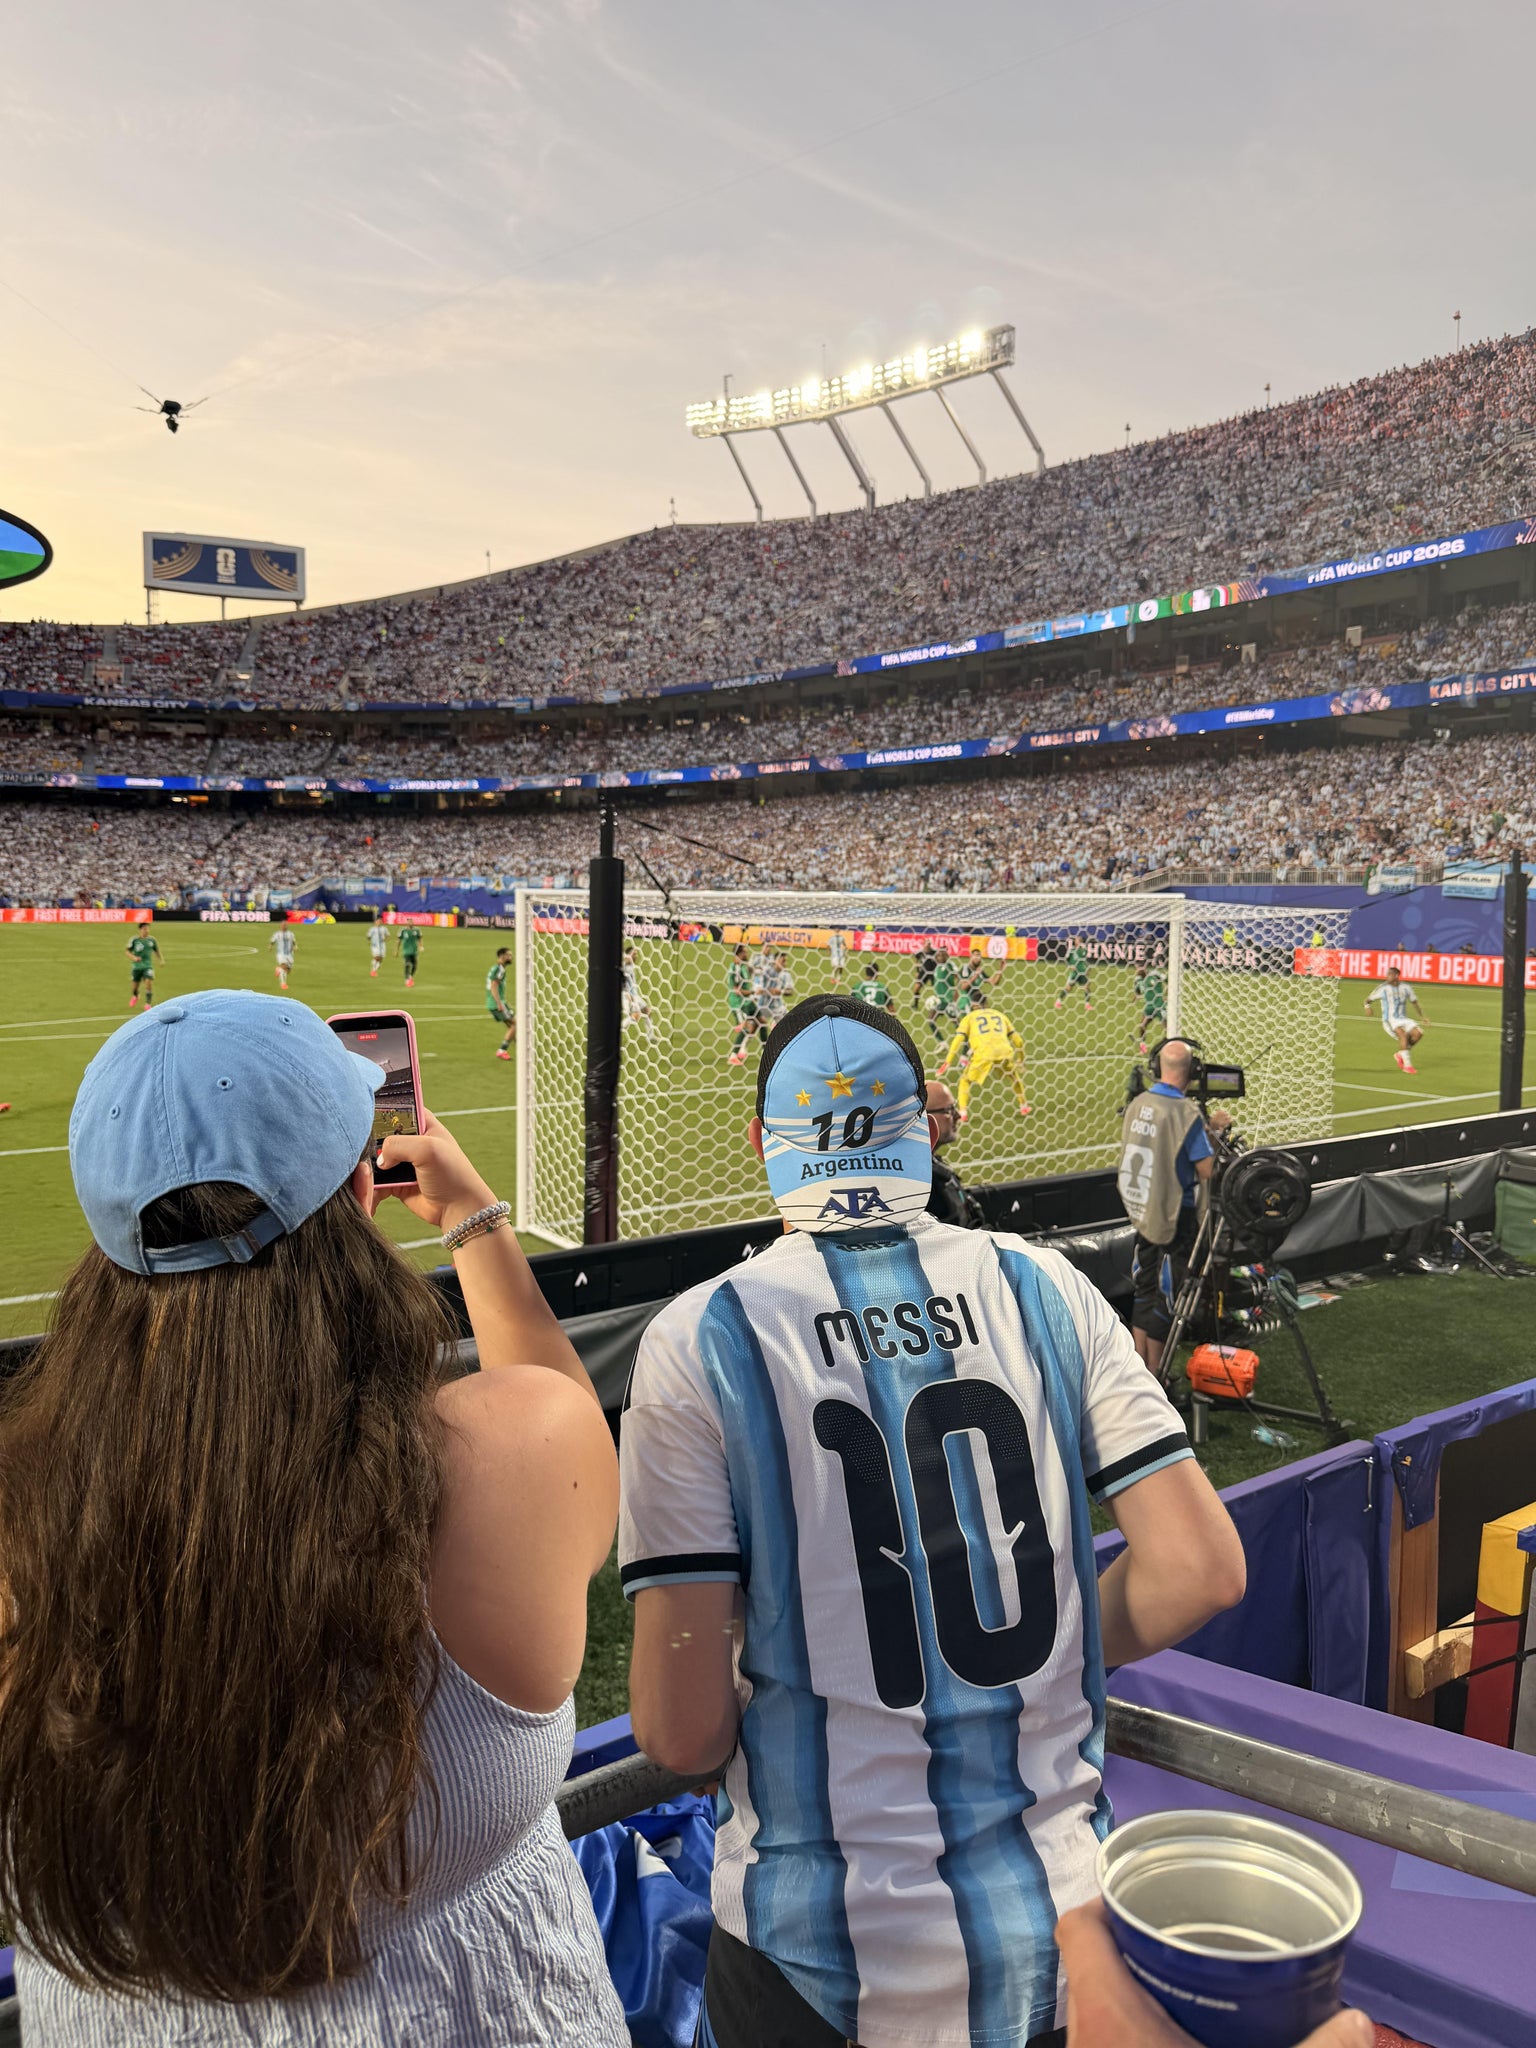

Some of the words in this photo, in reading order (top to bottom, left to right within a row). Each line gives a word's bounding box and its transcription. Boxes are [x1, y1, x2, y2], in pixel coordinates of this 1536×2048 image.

[1385, 549, 1413, 568] CUP
[1413, 538, 1466, 562] 2026
[900, 647, 929, 663] WORLD
[929, 644, 946, 658] CUP
[1429, 678, 1497, 699] KANSAS
[83, 697, 151, 708] KANSAS
[152, 700, 189, 709] CITY
[1074, 728, 1100, 743] CITY
[884, 749, 914, 763] WORLD
[914, 747, 931, 760] CUP
[931, 744, 962, 758] 2026
[60, 909, 82, 922] FREE
[201, 910, 230, 922] FIFA
[231, 911, 271, 922] STORE
[1338, 952, 1371, 977] THE
[1438, 956, 1504, 984] DEPOT
[976, 1015, 1004, 1035] 23
[812, 1105, 882, 1152] 10
[800, 1153, 904, 1181] Argentina
[817, 1186, 894, 1219] AFA
[813, 1293, 980, 1368] MESSI
[812, 1377, 1058, 1710] 10
